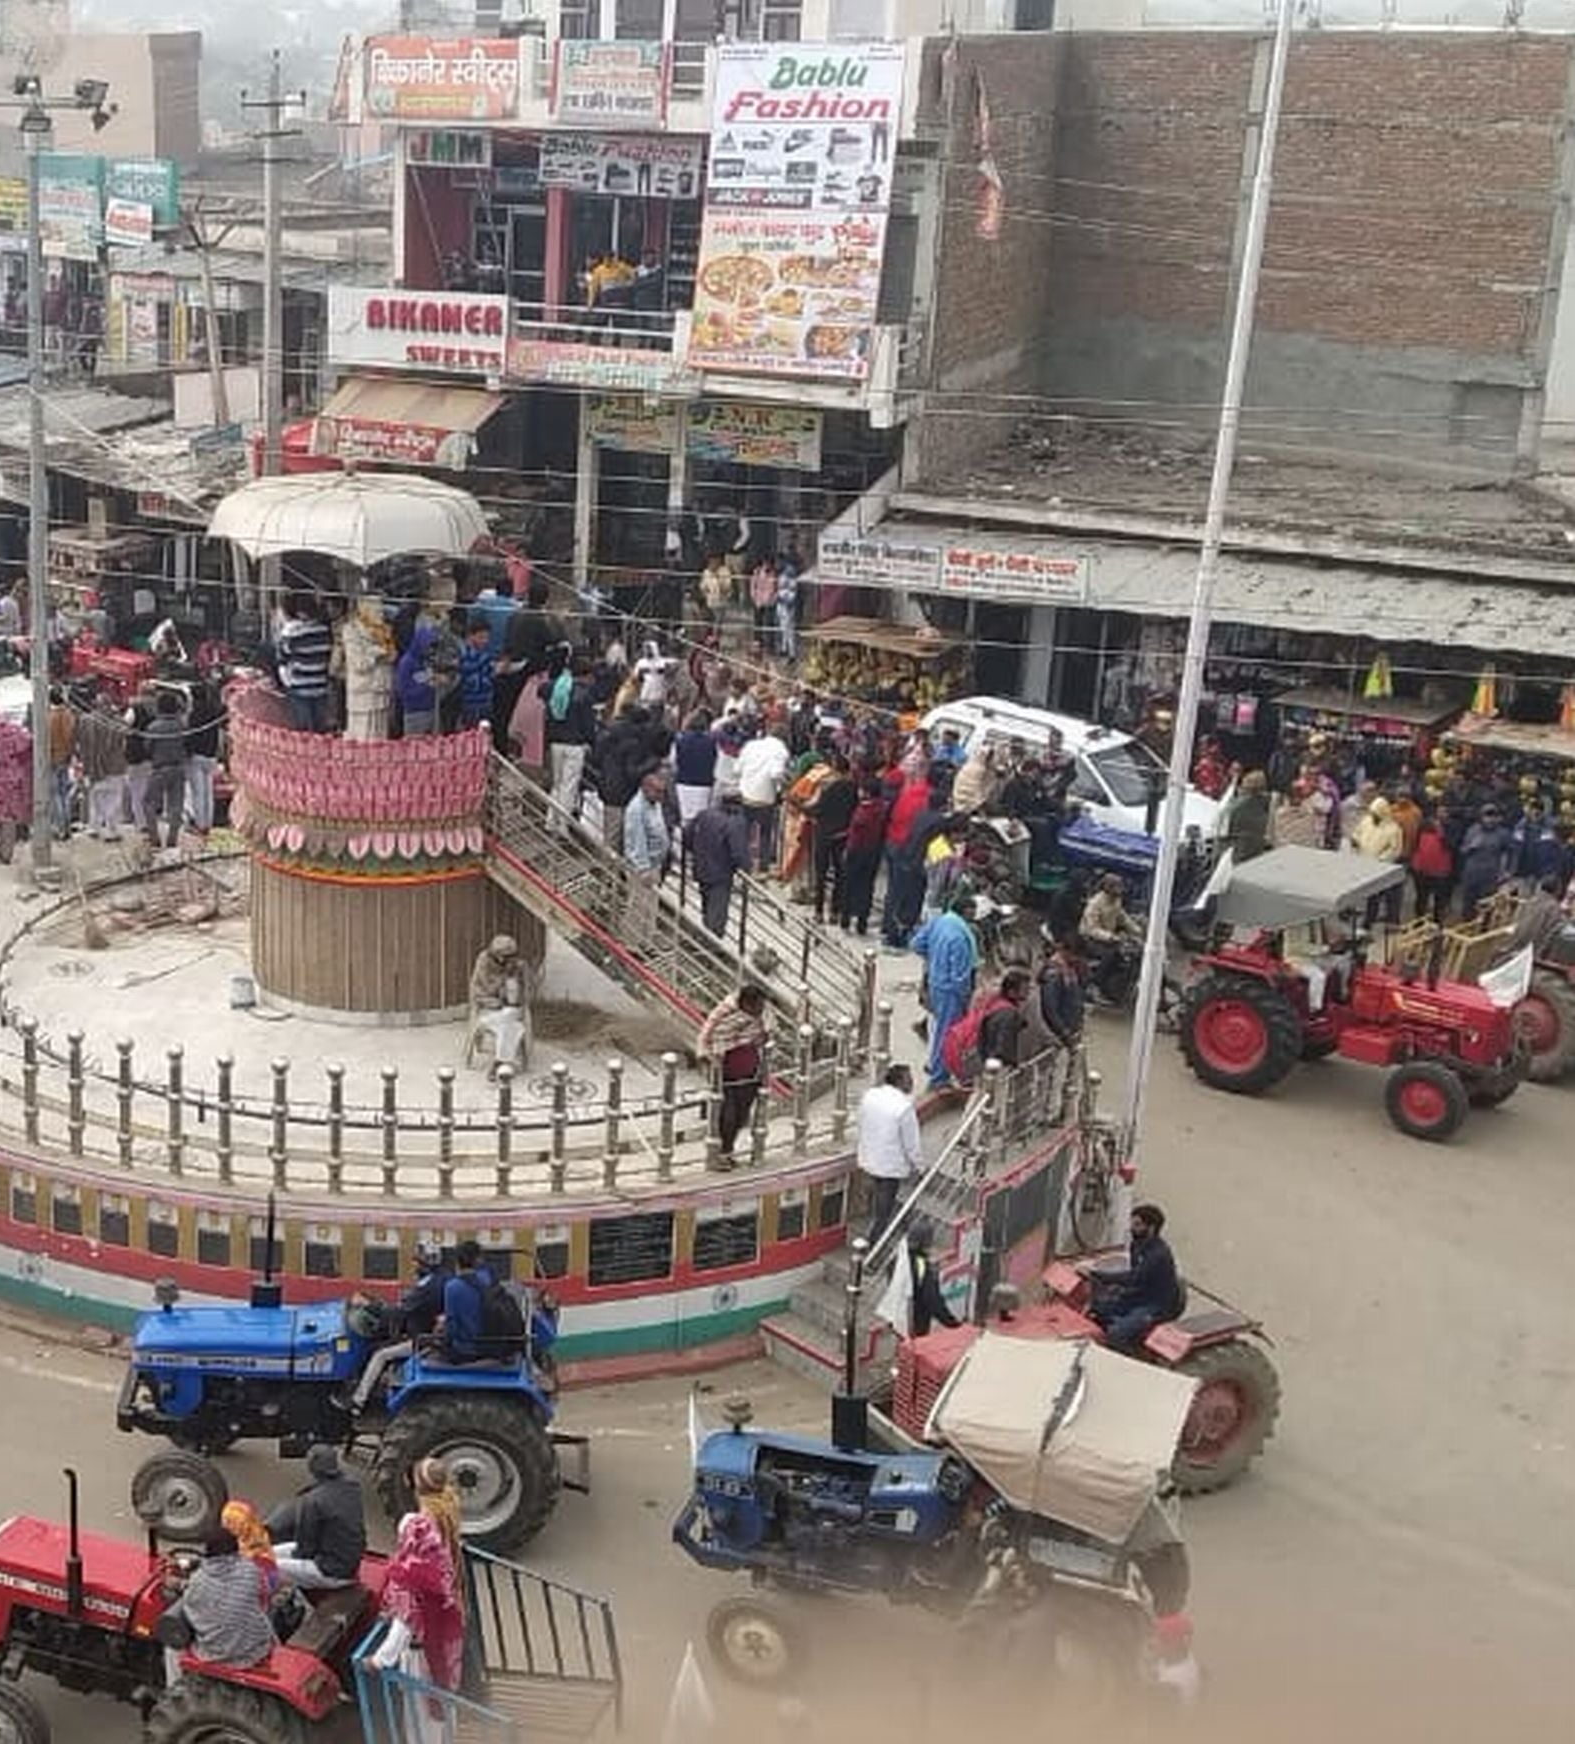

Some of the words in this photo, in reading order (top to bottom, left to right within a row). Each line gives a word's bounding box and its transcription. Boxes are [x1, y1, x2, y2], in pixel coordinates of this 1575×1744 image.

[769, 56, 869, 90] Bablu
[723, 91, 891, 122] Fashion
[366, 299, 503, 335] BIKANER
[406, 345, 502, 366] SWEETS
